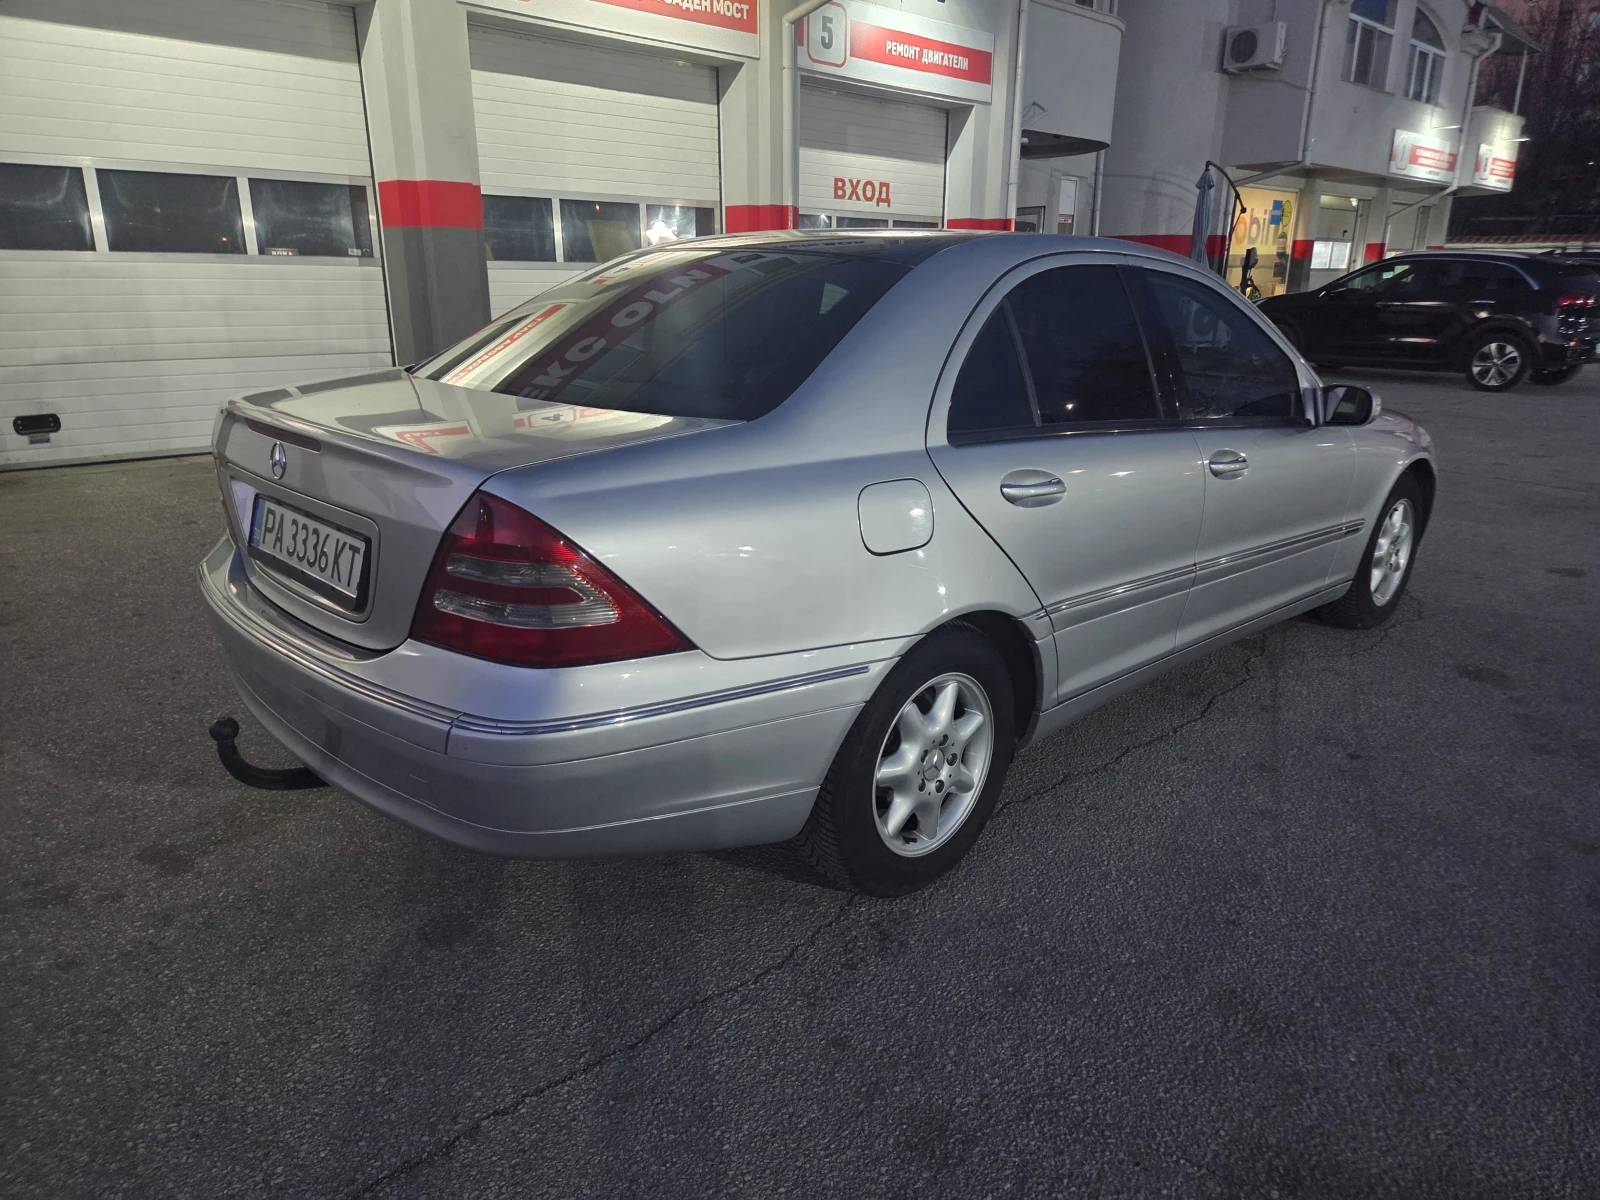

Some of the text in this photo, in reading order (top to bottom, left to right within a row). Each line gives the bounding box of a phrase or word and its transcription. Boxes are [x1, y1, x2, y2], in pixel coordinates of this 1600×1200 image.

[713, 0, 749, 19] МОСТ
[820, 15, 834, 50] 5
[886, 40, 969, 71] РЕМОНТ ДВИГАТЕЛИ
[833, 177, 891, 208] ВХОД
